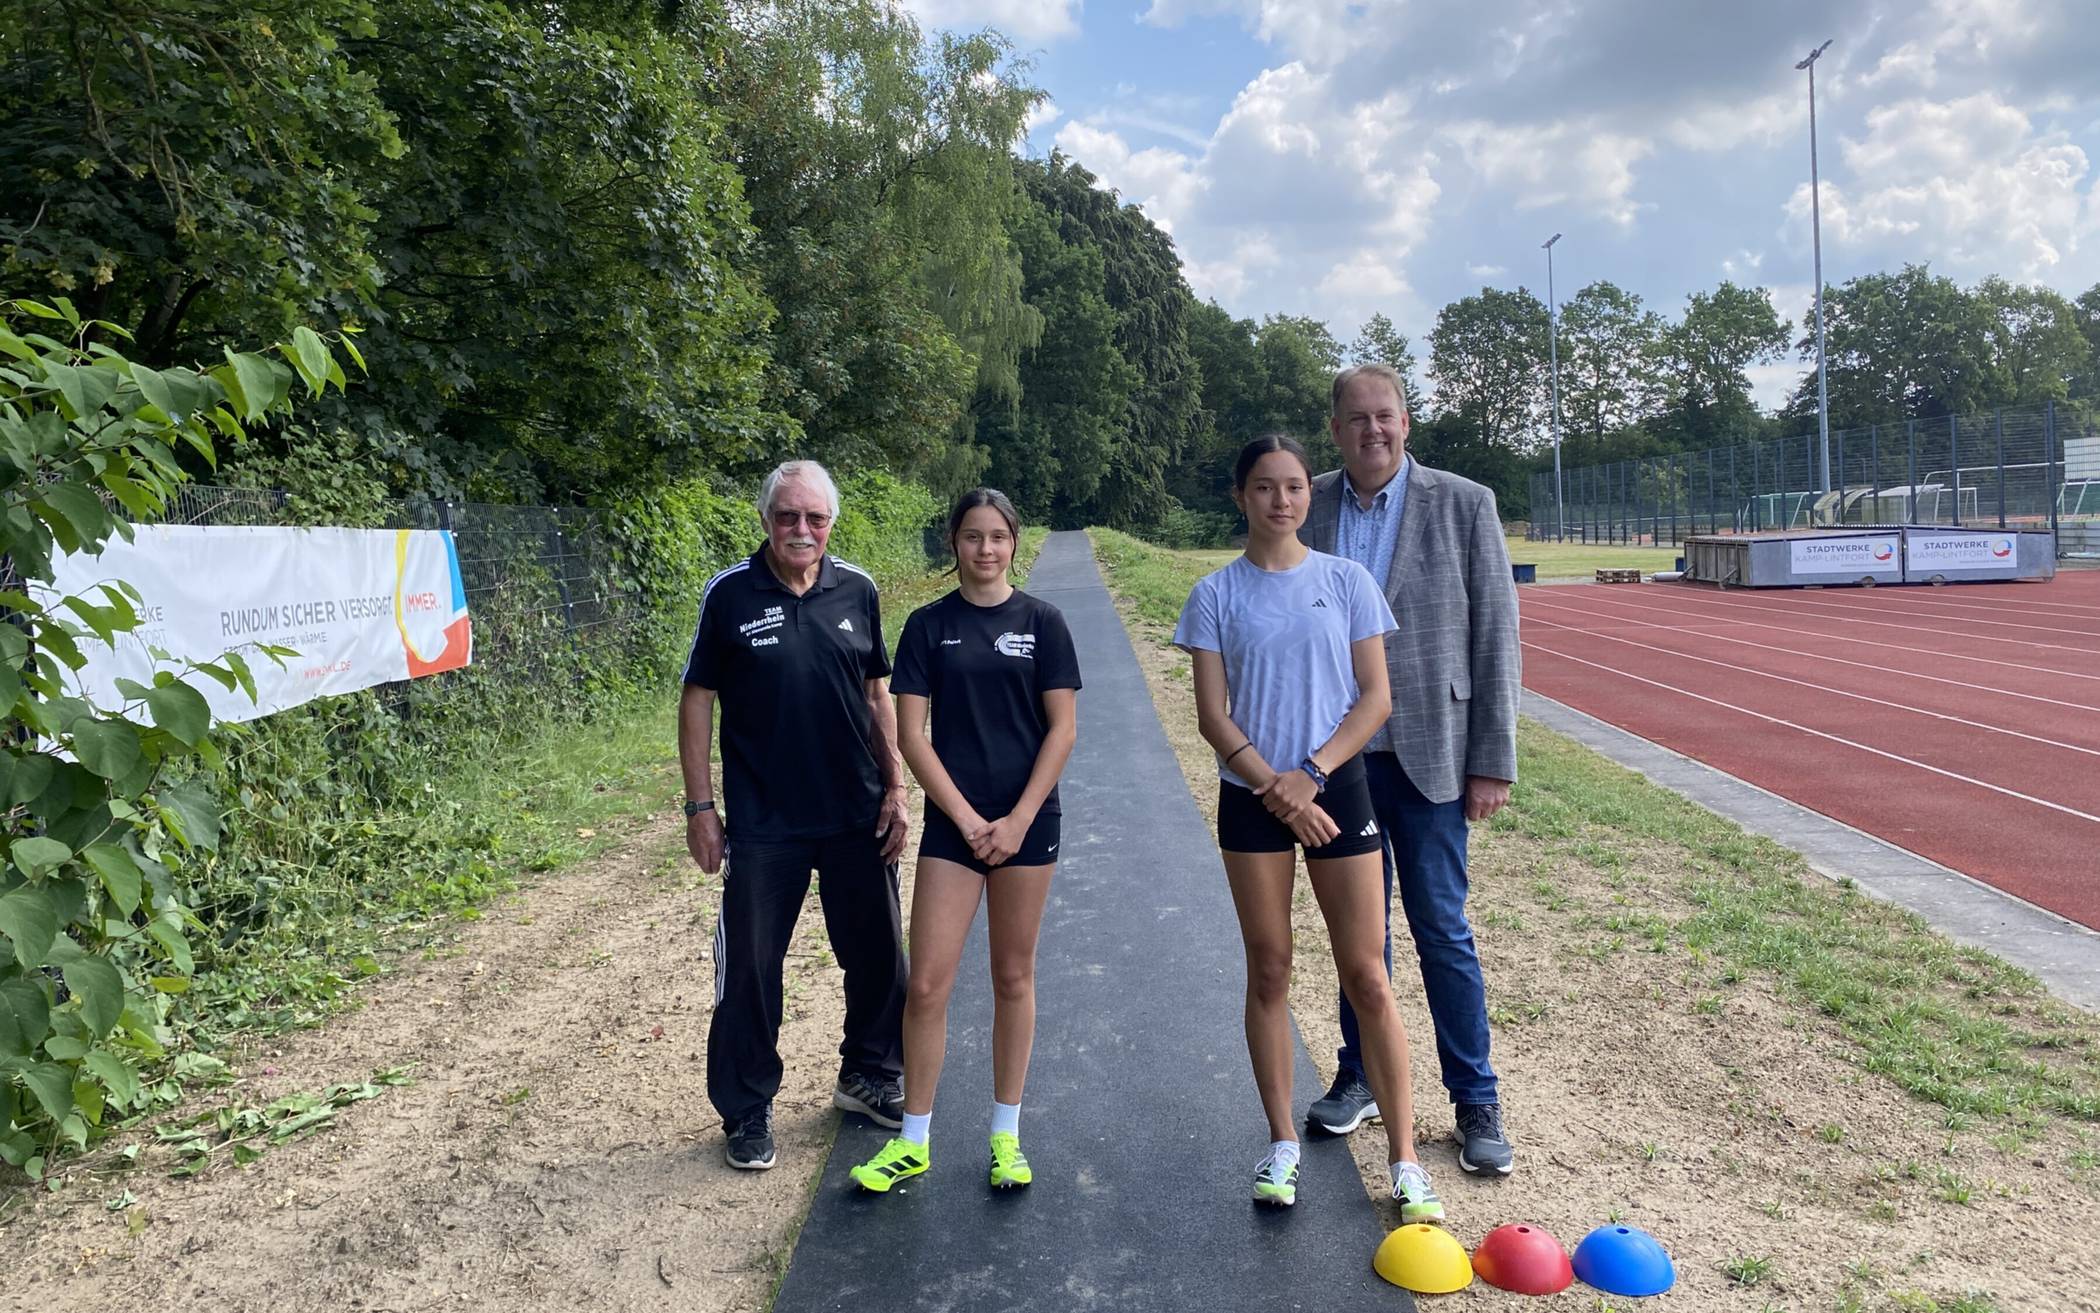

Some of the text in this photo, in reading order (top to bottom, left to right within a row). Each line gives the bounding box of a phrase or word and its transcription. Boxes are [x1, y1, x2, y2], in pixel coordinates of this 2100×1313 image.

[1806, 544, 1870, 554] STADTWERKE
[1924, 540, 1989, 550] STADTWERKE
[1911, 550, 1988, 560] KAMP-LINTFORT
[764, 606, 782, 614] TEAM
[220, 606, 280, 637] RUNDUM
[282, 600, 337, 628] SICHER
[740, 614, 785, 633] Niederrhein
[751, 635, 779, 647] Coach
